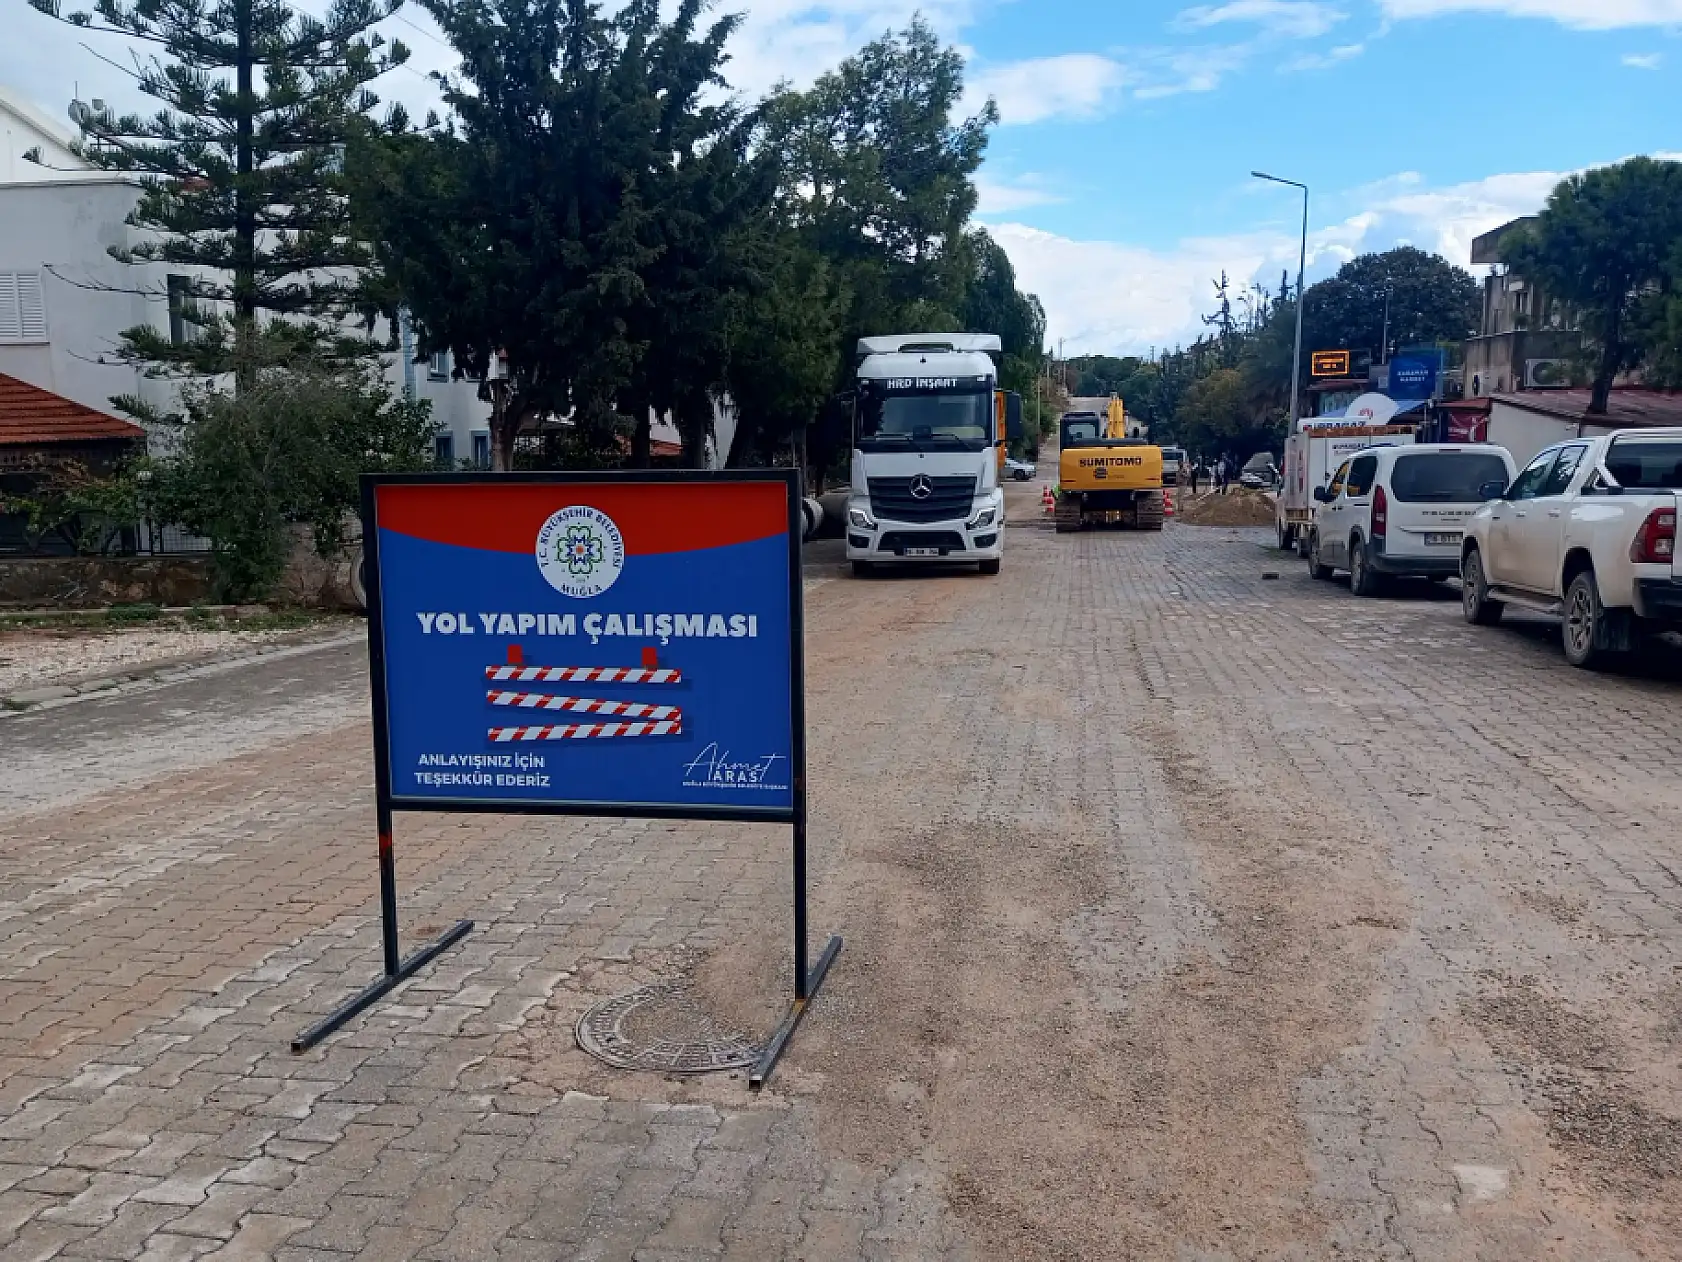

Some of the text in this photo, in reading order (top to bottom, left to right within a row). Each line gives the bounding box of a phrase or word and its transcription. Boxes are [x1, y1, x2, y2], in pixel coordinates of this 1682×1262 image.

[1079, 456, 1142, 467] SUMITOMO
[561, 583, 603, 596] MUĞLA
[416, 612, 758, 646] YOL YAPIM ÇALIŞMASI
[418, 751, 546, 771] ANLAYIŞINIZ İÇİN
[414, 770, 551, 788] TEŞEKKÜR EDERİZ
[713, 770, 758, 783] ARAS
